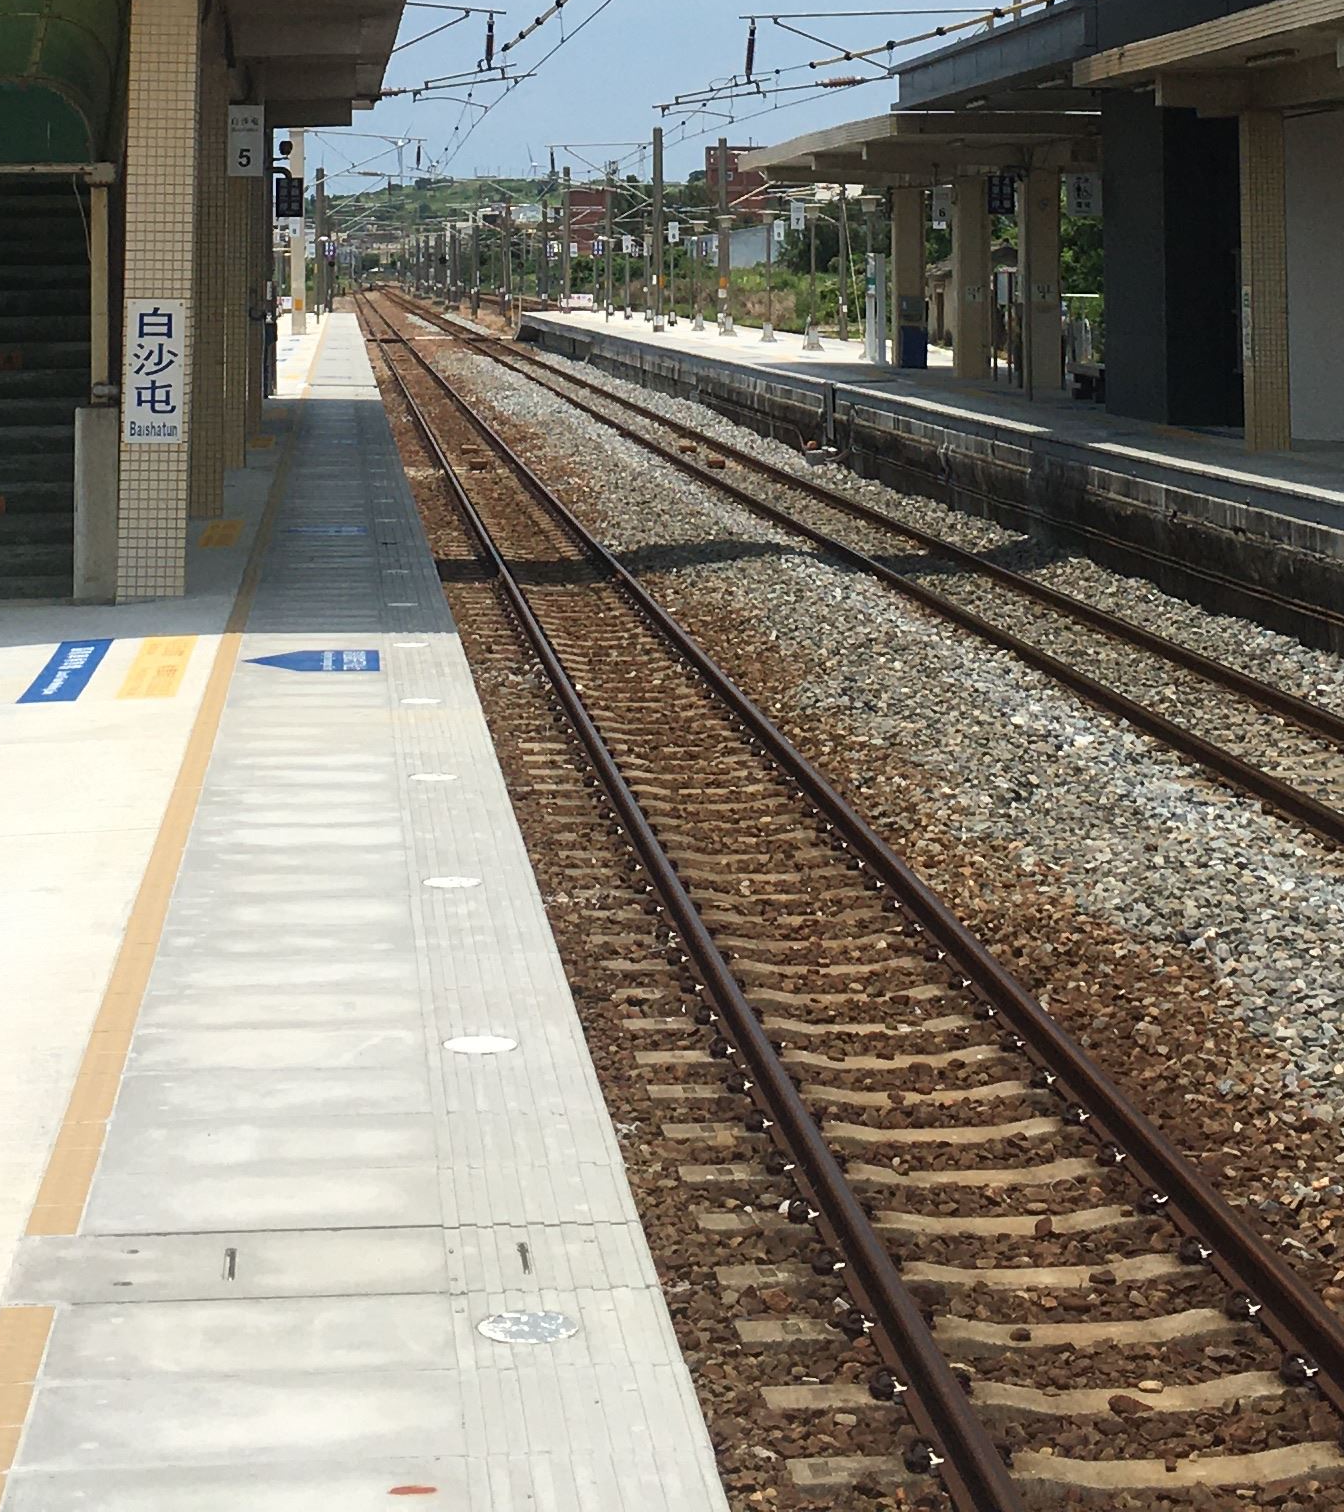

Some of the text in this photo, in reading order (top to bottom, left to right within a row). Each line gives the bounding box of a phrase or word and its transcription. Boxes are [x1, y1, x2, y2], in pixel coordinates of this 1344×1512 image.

[238, 148, 251, 167] 5
[133, 307, 179, 414] 白沙屯
[129, 421, 178, 437] Baishatun
